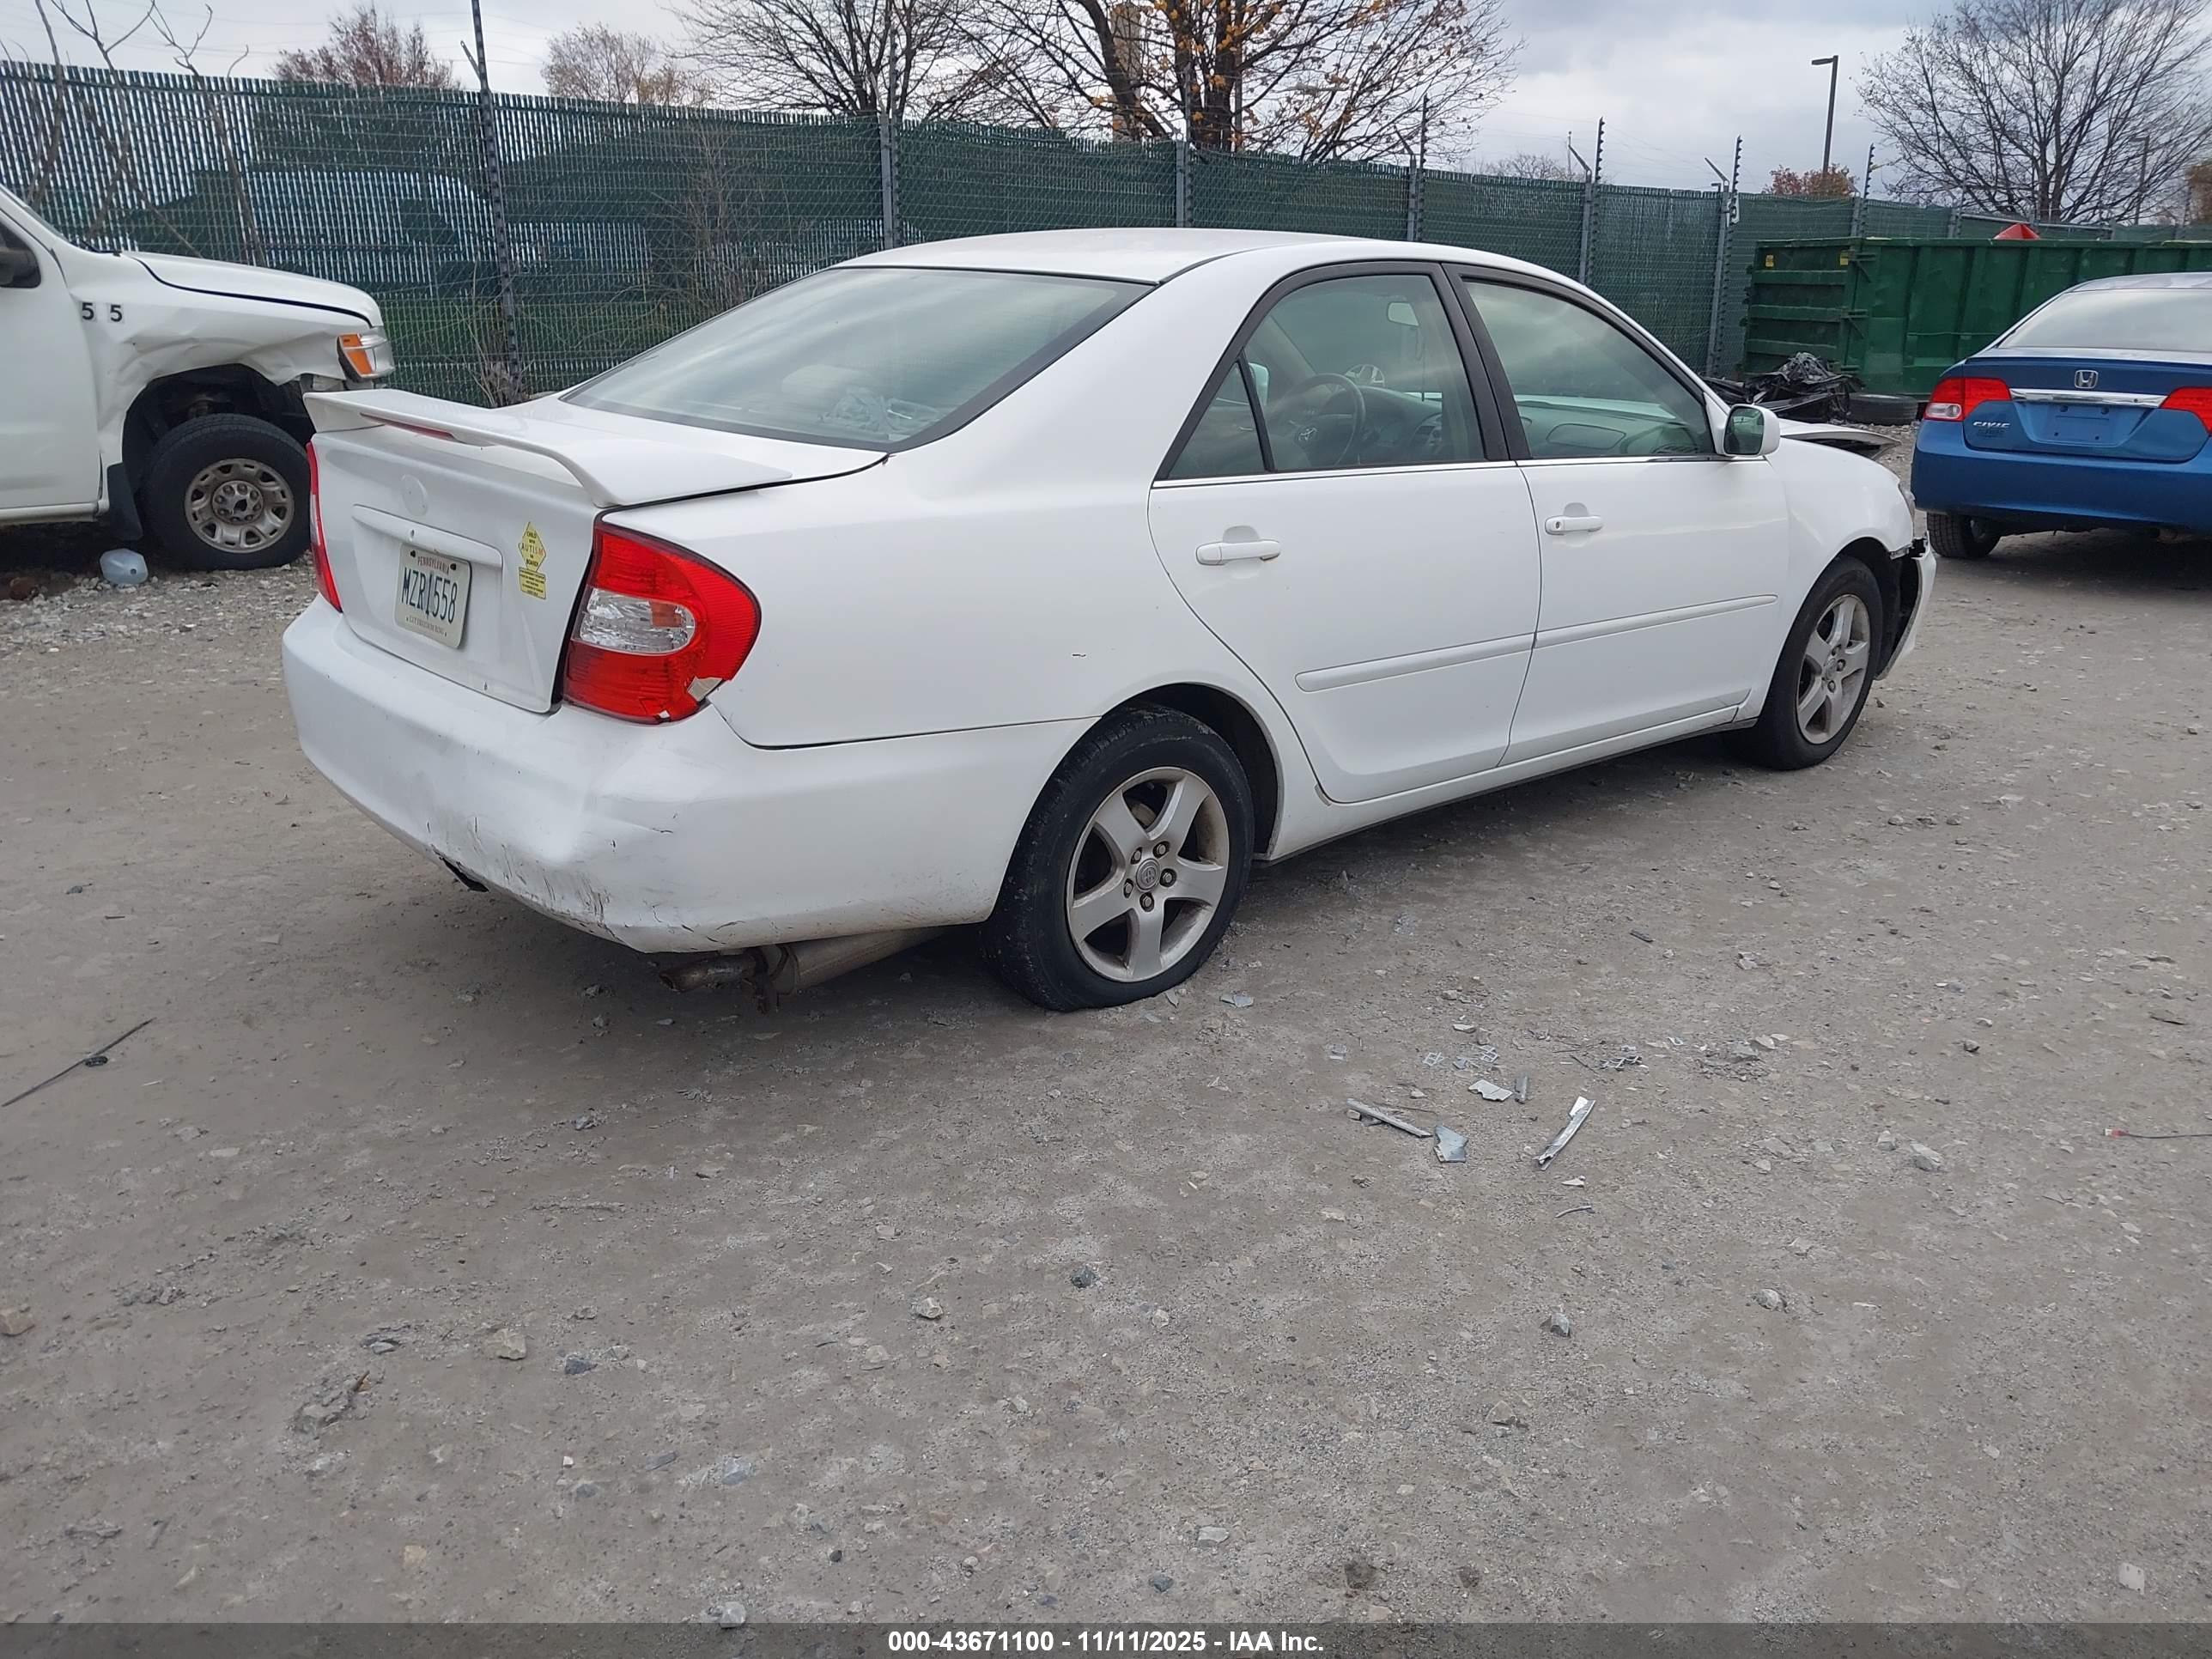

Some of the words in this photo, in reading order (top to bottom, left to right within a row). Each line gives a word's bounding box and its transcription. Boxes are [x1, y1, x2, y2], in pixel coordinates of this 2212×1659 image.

[82, 302, 94, 320] 5
[110, 304, 123, 322] 5
[521, 543, 545, 556] AUTISM
[417, 556, 450, 576] PENNSYLVANIA
